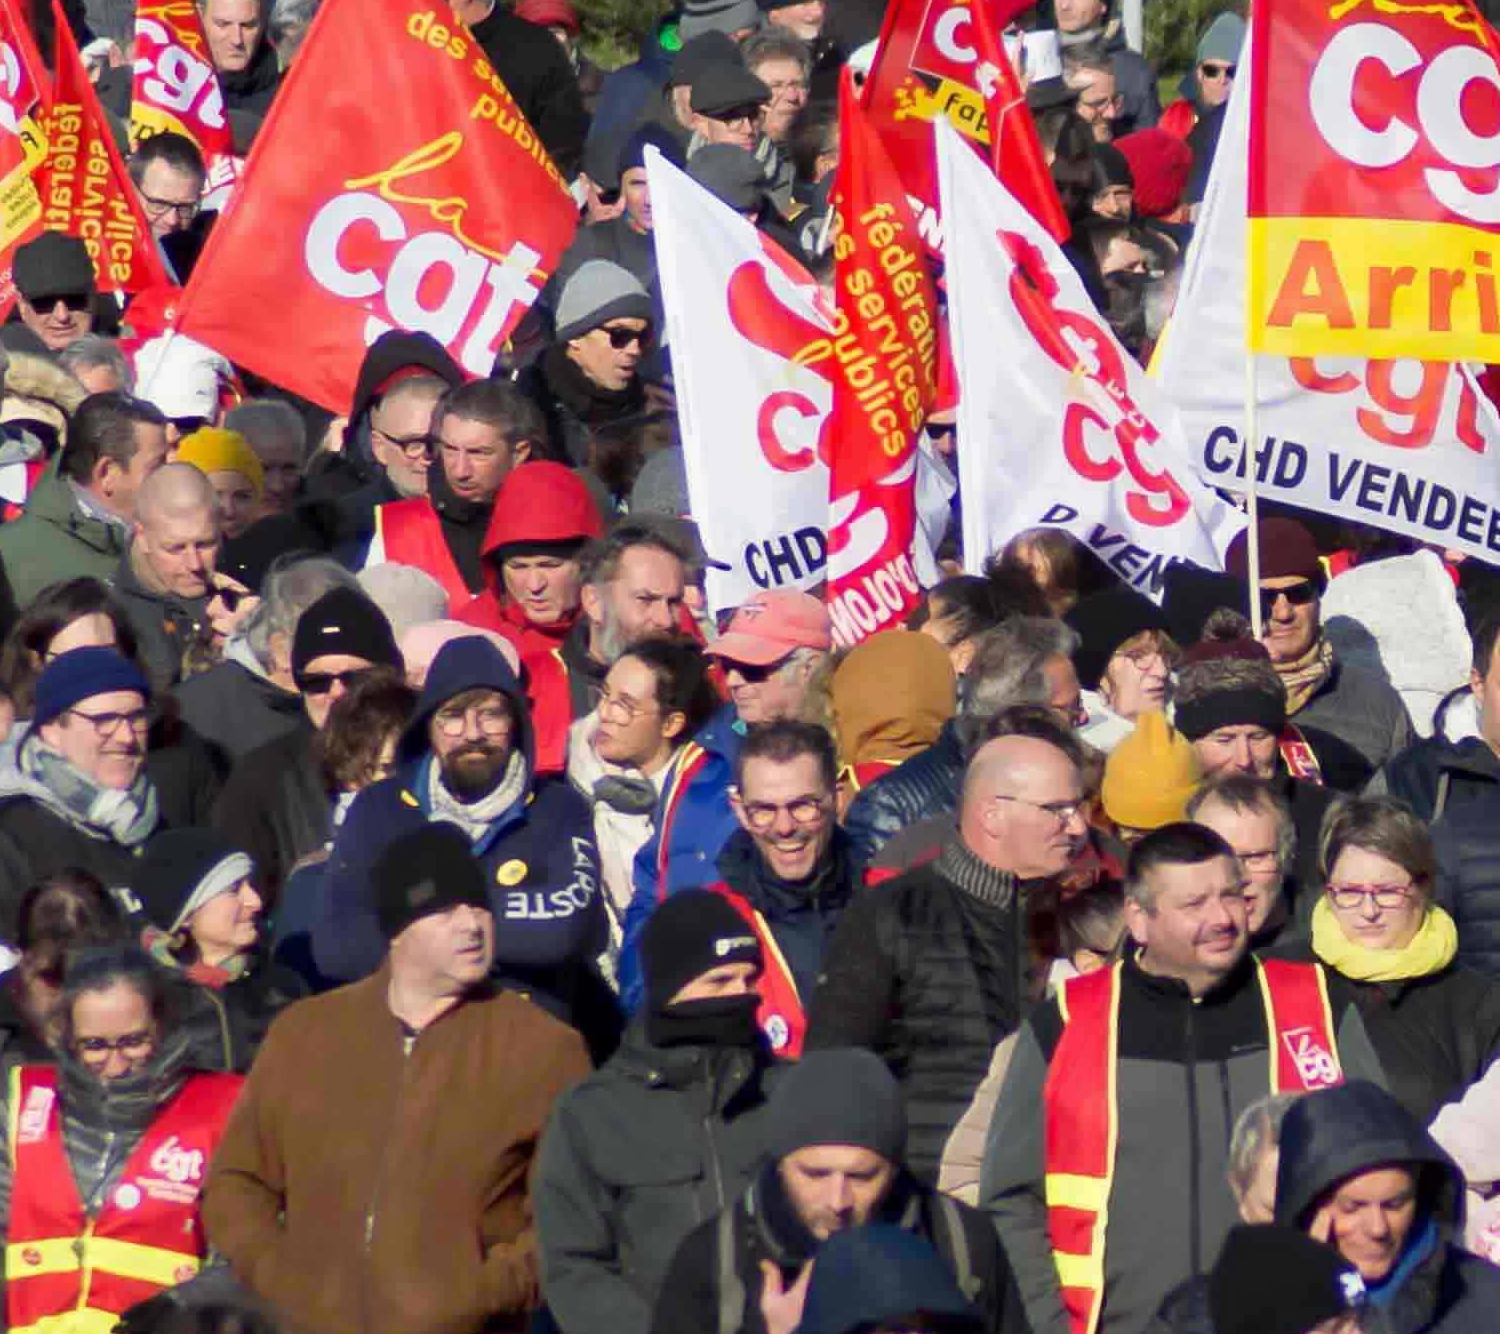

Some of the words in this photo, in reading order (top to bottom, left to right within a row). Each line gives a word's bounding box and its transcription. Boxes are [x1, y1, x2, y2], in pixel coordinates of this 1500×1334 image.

[405, 10, 468, 61] des
[304, 191, 543, 380] cgt
[845, 267, 924, 433] services
[1203, 425, 1308, 489] CHD
[744, 526, 828, 590] CHD
[571, 835, 596, 870] LA
[505, 869, 597, 919] POSTE
